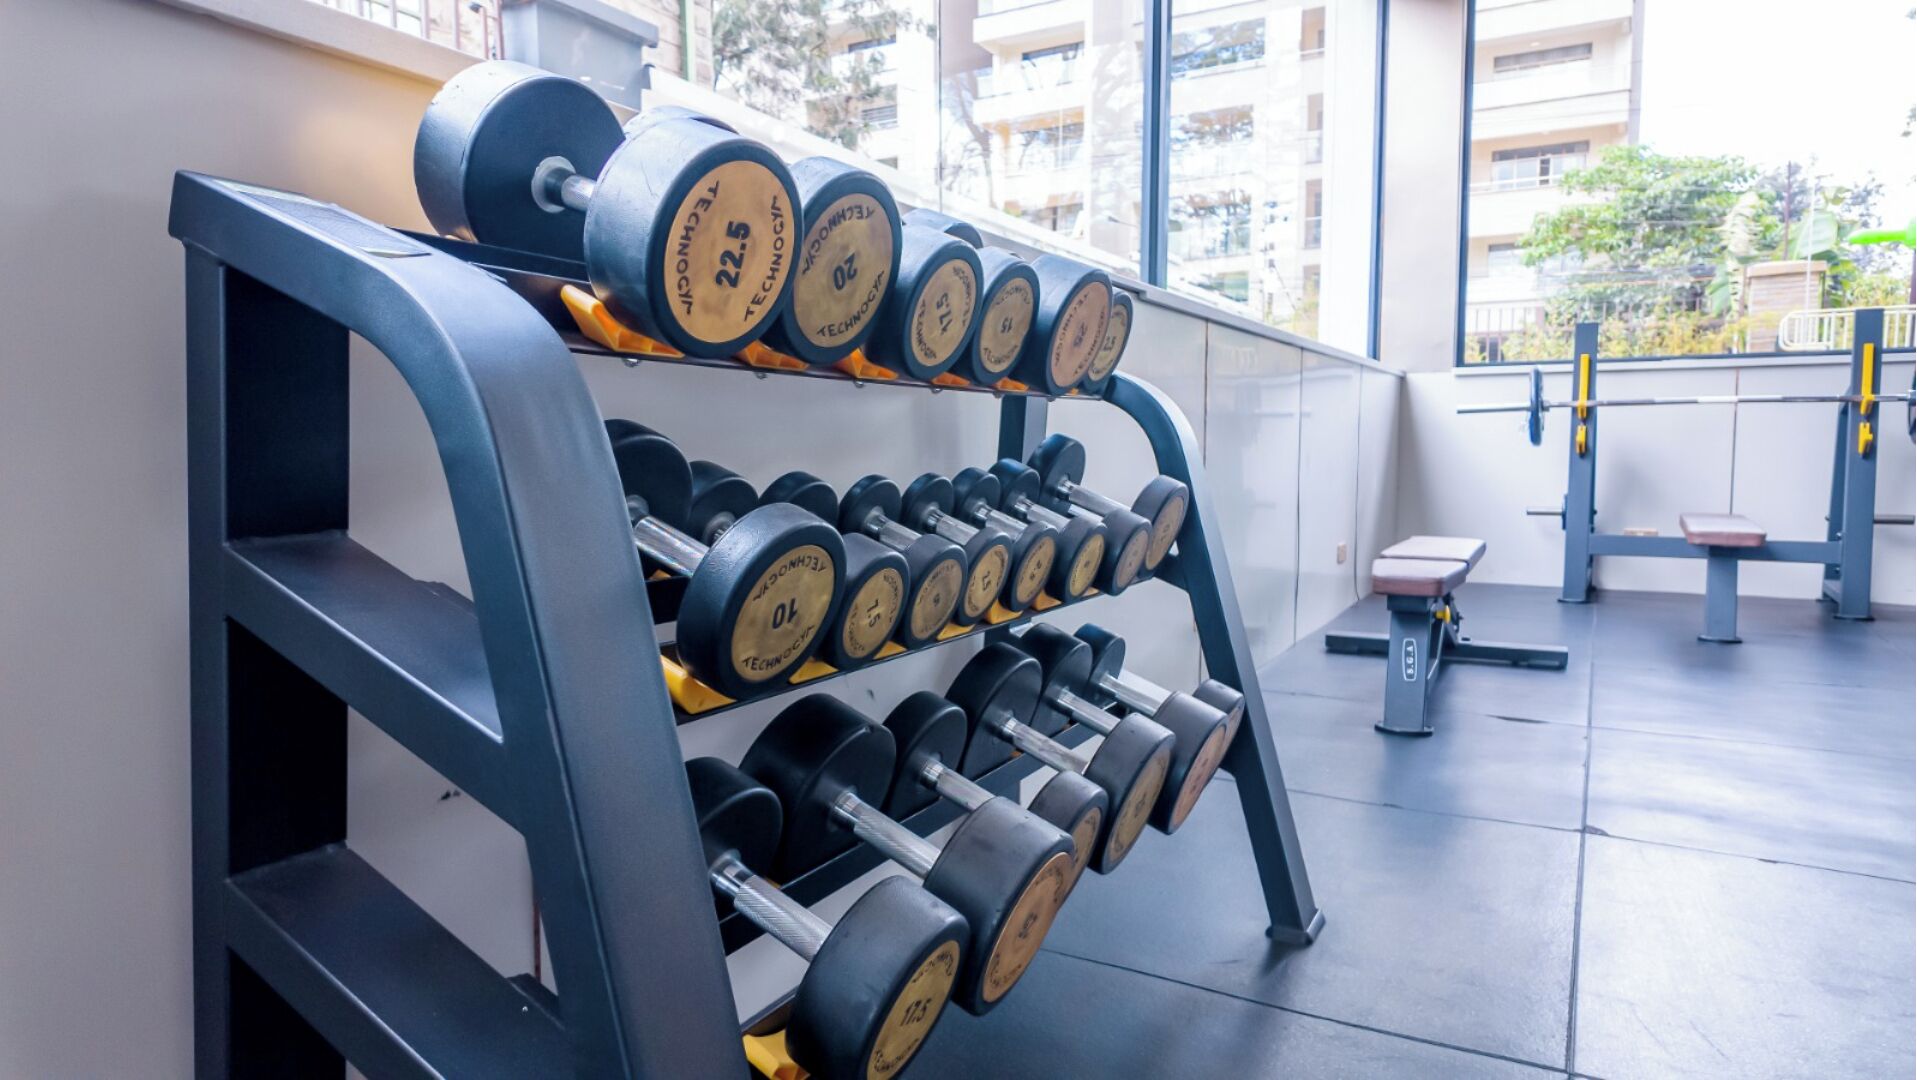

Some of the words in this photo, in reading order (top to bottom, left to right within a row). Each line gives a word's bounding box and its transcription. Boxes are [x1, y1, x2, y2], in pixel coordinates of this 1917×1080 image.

[716, 220, 751, 289] 22.5
[833, 252, 859, 291] 20
[936, 292, 954, 336] 17.5
[1000, 317, 1013, 334] 15
[772, 598, 798, 630] 10
[900, 998, 932, 1027] 17.5
